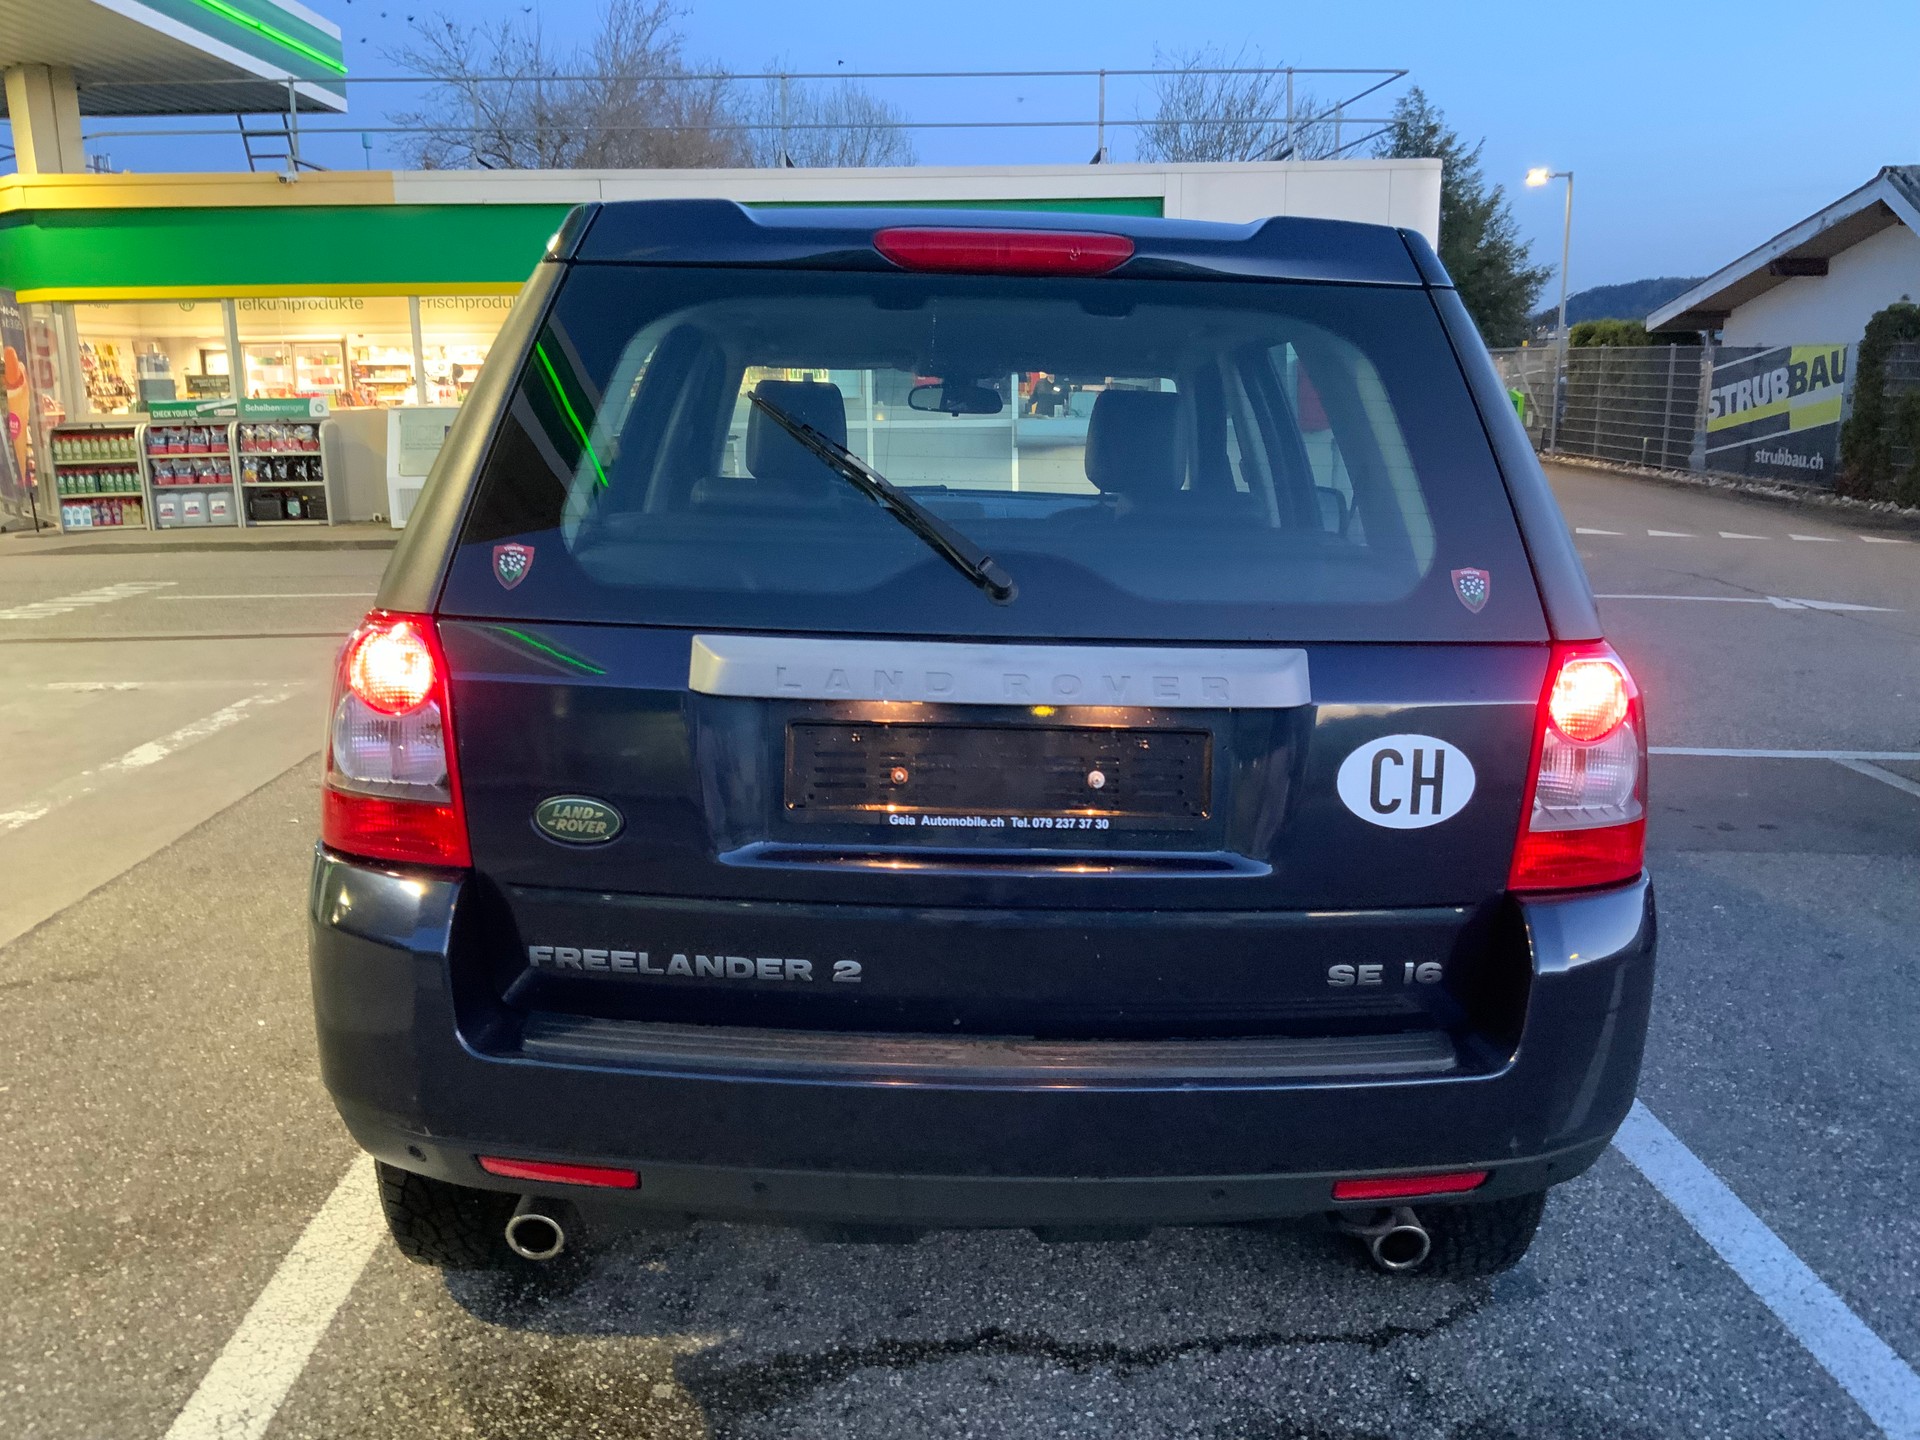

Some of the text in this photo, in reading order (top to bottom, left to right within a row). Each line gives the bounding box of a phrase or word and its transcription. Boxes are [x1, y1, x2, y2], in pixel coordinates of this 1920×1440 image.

[1708, 350, 1847, 419] STRUBBAU
[152, 410, 172, 418] CHECK
[172, 409, 188, 417] YOUR
[1755, 448, 1824, 470] strubbau.ch
[775, 665, 1232, 702] LAND ROVER
[1370, 749, 1445, 815] CH
[921, 815, 1005, 828] Automobile.ch
[1010, 817, 1031, 828] Tel.
[1032, 818, 1053, 828] 079
[1055, 818, 1076, 829] 237
[1078, 818, 1093, 829] 37
[1095, 819, 1109, 830] 30
[528, 945, 862, 983] FREELANDER 2
[1327, 964, 1384, 986] SE
